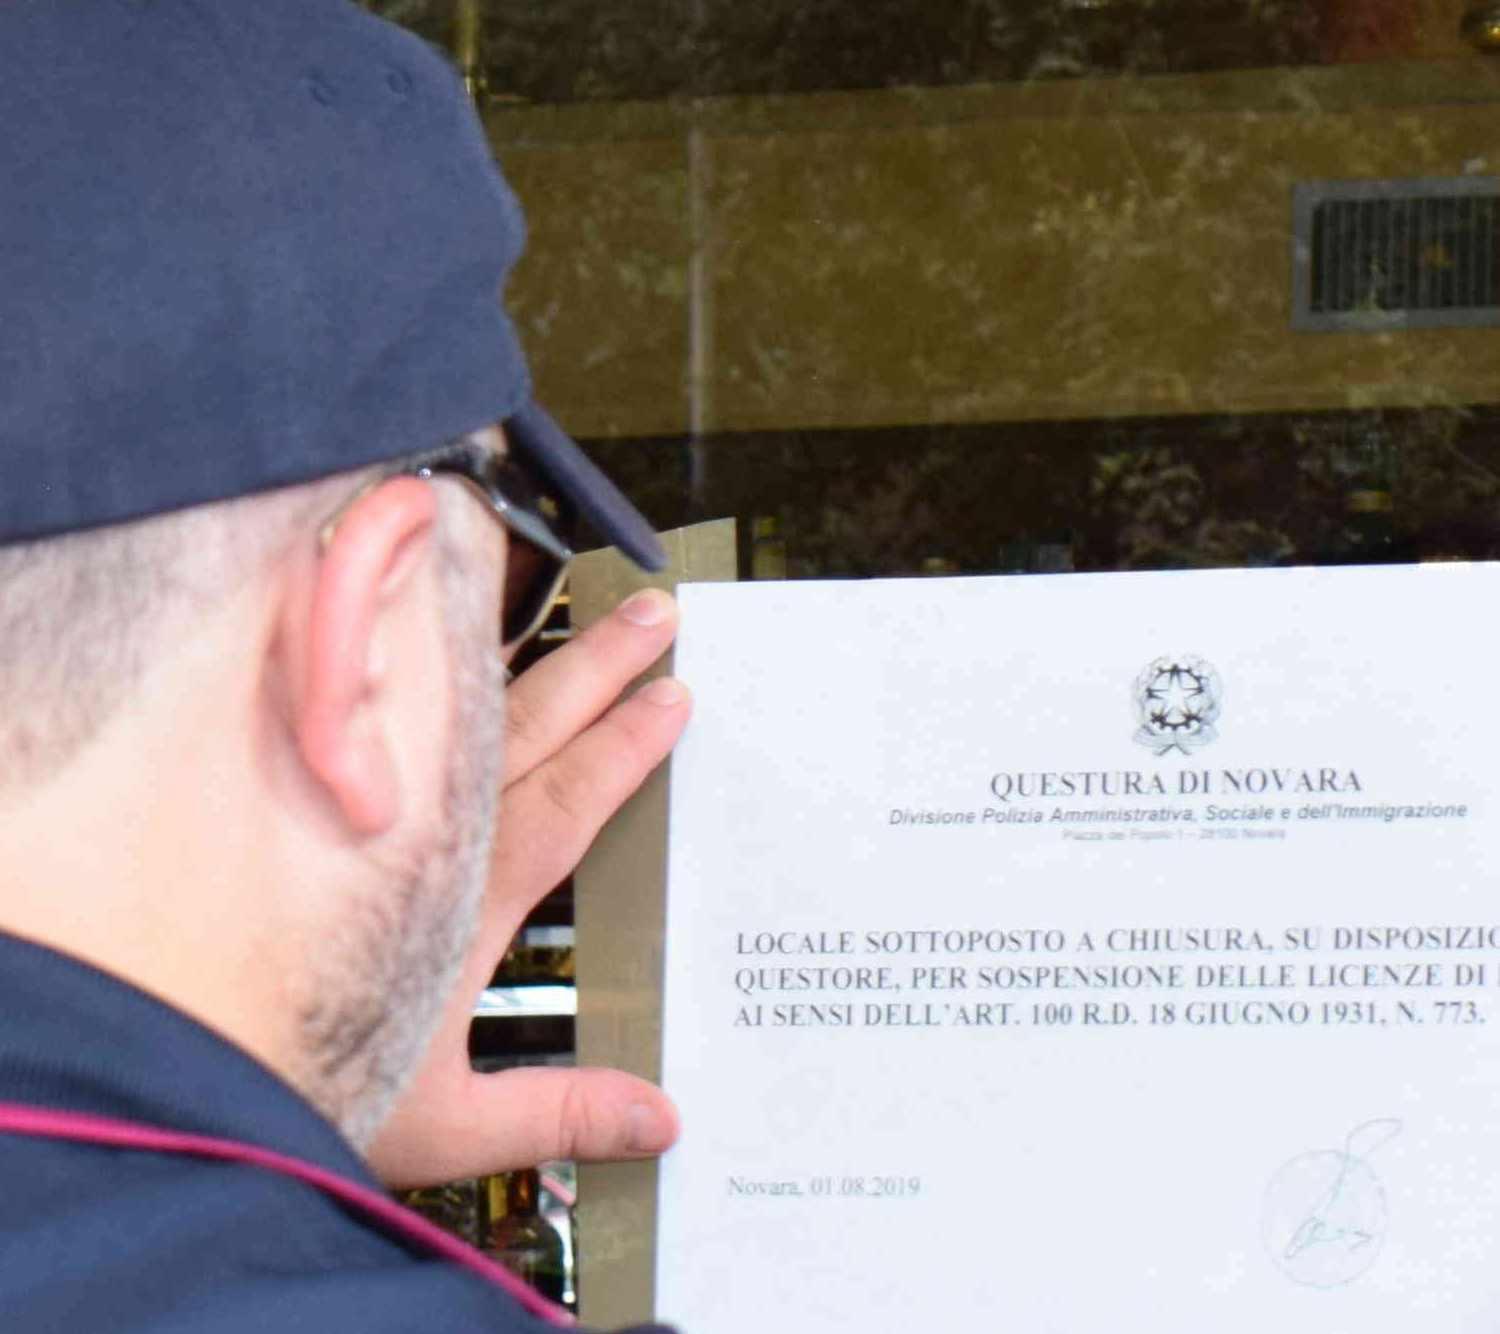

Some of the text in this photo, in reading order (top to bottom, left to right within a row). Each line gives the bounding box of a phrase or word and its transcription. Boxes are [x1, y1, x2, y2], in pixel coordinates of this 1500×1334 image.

[990, 768, 1363, 802] QUESTURA DI NOVARA
[888, 802, 1468, 825] Divisione Polizia Amministrativa, Sociale e dell'Immigrazione
[736, 931, 855, 955] LOCALE
[865, 930, 1066, 954] SOTTOPOSTO
[1076, 931, 1096, 952] A
[1106, 928, 1274, 955] CHIUSURA,
[1284, 928, 1320, 951] SU
[735, 967, 901, 995] QUESTORE,
[911, 967, 968, 989] PER
[978, 965, 1184, 989] SOSPENSIONE
[1196, 965, 1296, 988] DELLE
[1307, 964, 1442, 988] LICENZE
[1455, 964, 1485, 987] DI
[734, 1004, 763, 1027] AI
[772, 1003, 853, 1027] SENSI
[1032, 1003, 1073, 1026] 100
[1082, 1003, 1138, 1026] R.D.
[1149, 1002, 1177, 1025] 18
[1185, 1002, 1311, 1026] GIUGNO
[1321, 1001, 1387, 1027] 1931,
[1397, 1001, 1424, 1024] N.
[1434, 1001, 1485, 1024] 773.
[727, 1176, 921, 1198] Novara, 01.08.2019
